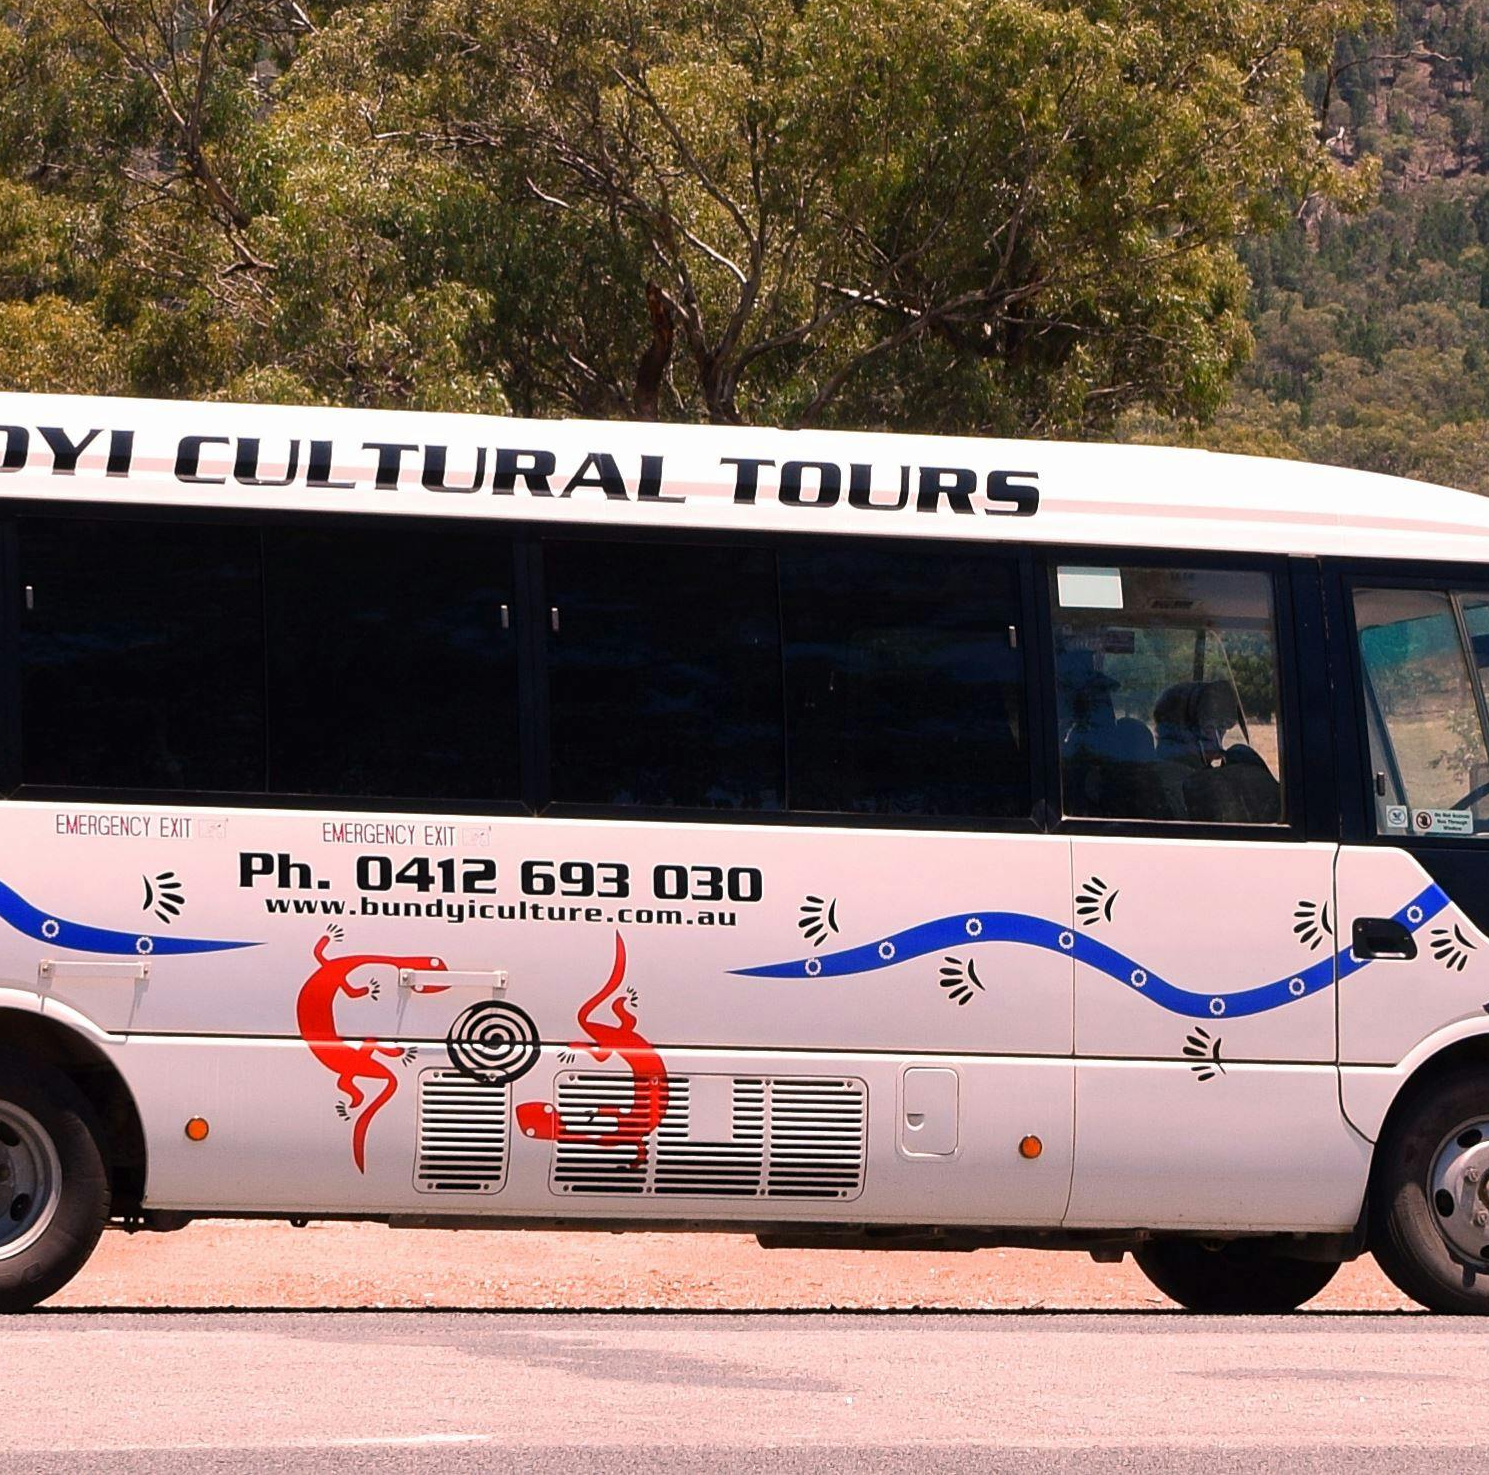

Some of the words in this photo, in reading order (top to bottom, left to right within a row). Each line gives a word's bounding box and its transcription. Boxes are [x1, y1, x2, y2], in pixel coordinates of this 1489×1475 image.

[174, 434, 686, 503] CULTURAL
[721, 458, 1039, 516] TOURS
[56, 814, 151, 837] EMERGENCY
[160, 817, 192, 838] EXIT
[322, 823, 415, 845] EMERGENCY
[424, 826, 455, 846] EXIT
[240, 853, 329, 890] Ph.
[356, 856, 496, 893] 0412
[520, 861, 629, 899] 693
[654, 865, 763, 903] 030
[265, 897, 737, 925] www.bundyiculture.com.au
